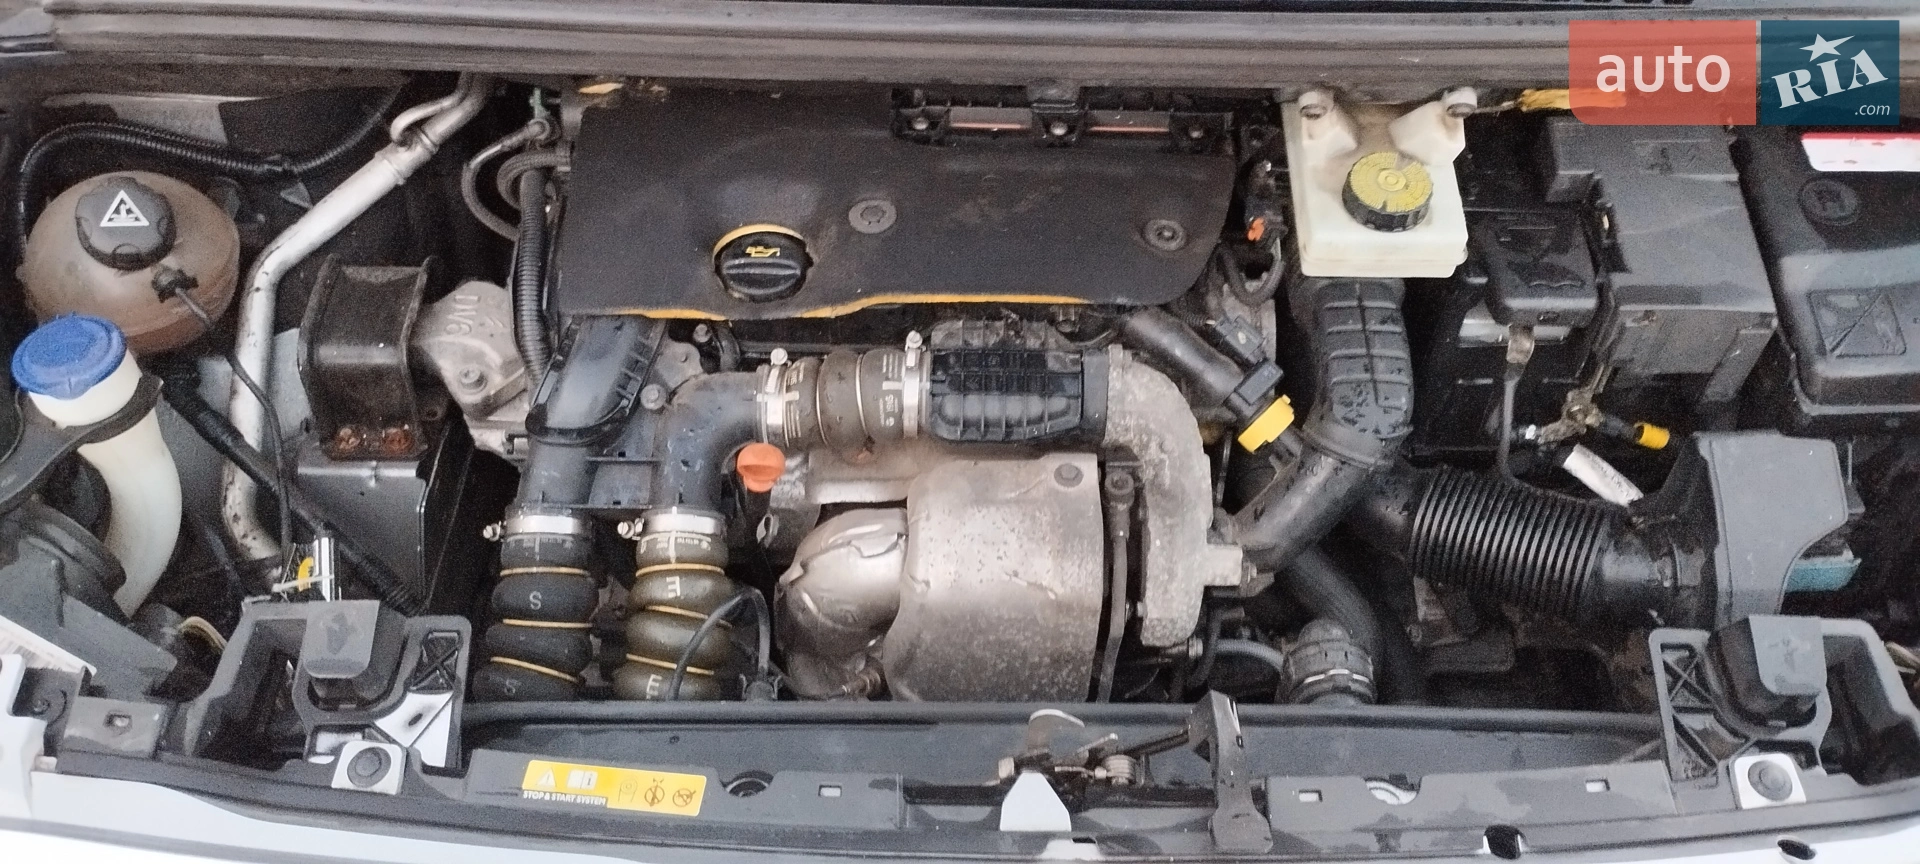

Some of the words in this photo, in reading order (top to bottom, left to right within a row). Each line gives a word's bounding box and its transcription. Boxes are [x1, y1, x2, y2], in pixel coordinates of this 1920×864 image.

[445, 295, 481, 336] DV6
[529, 591, 542, 610] S
[522, 790, 545, 800] STOP
[544, 792, 550, 801] &
[551, 792, 577, 803] START
[576, 794, 607, 806] SYSTEM
